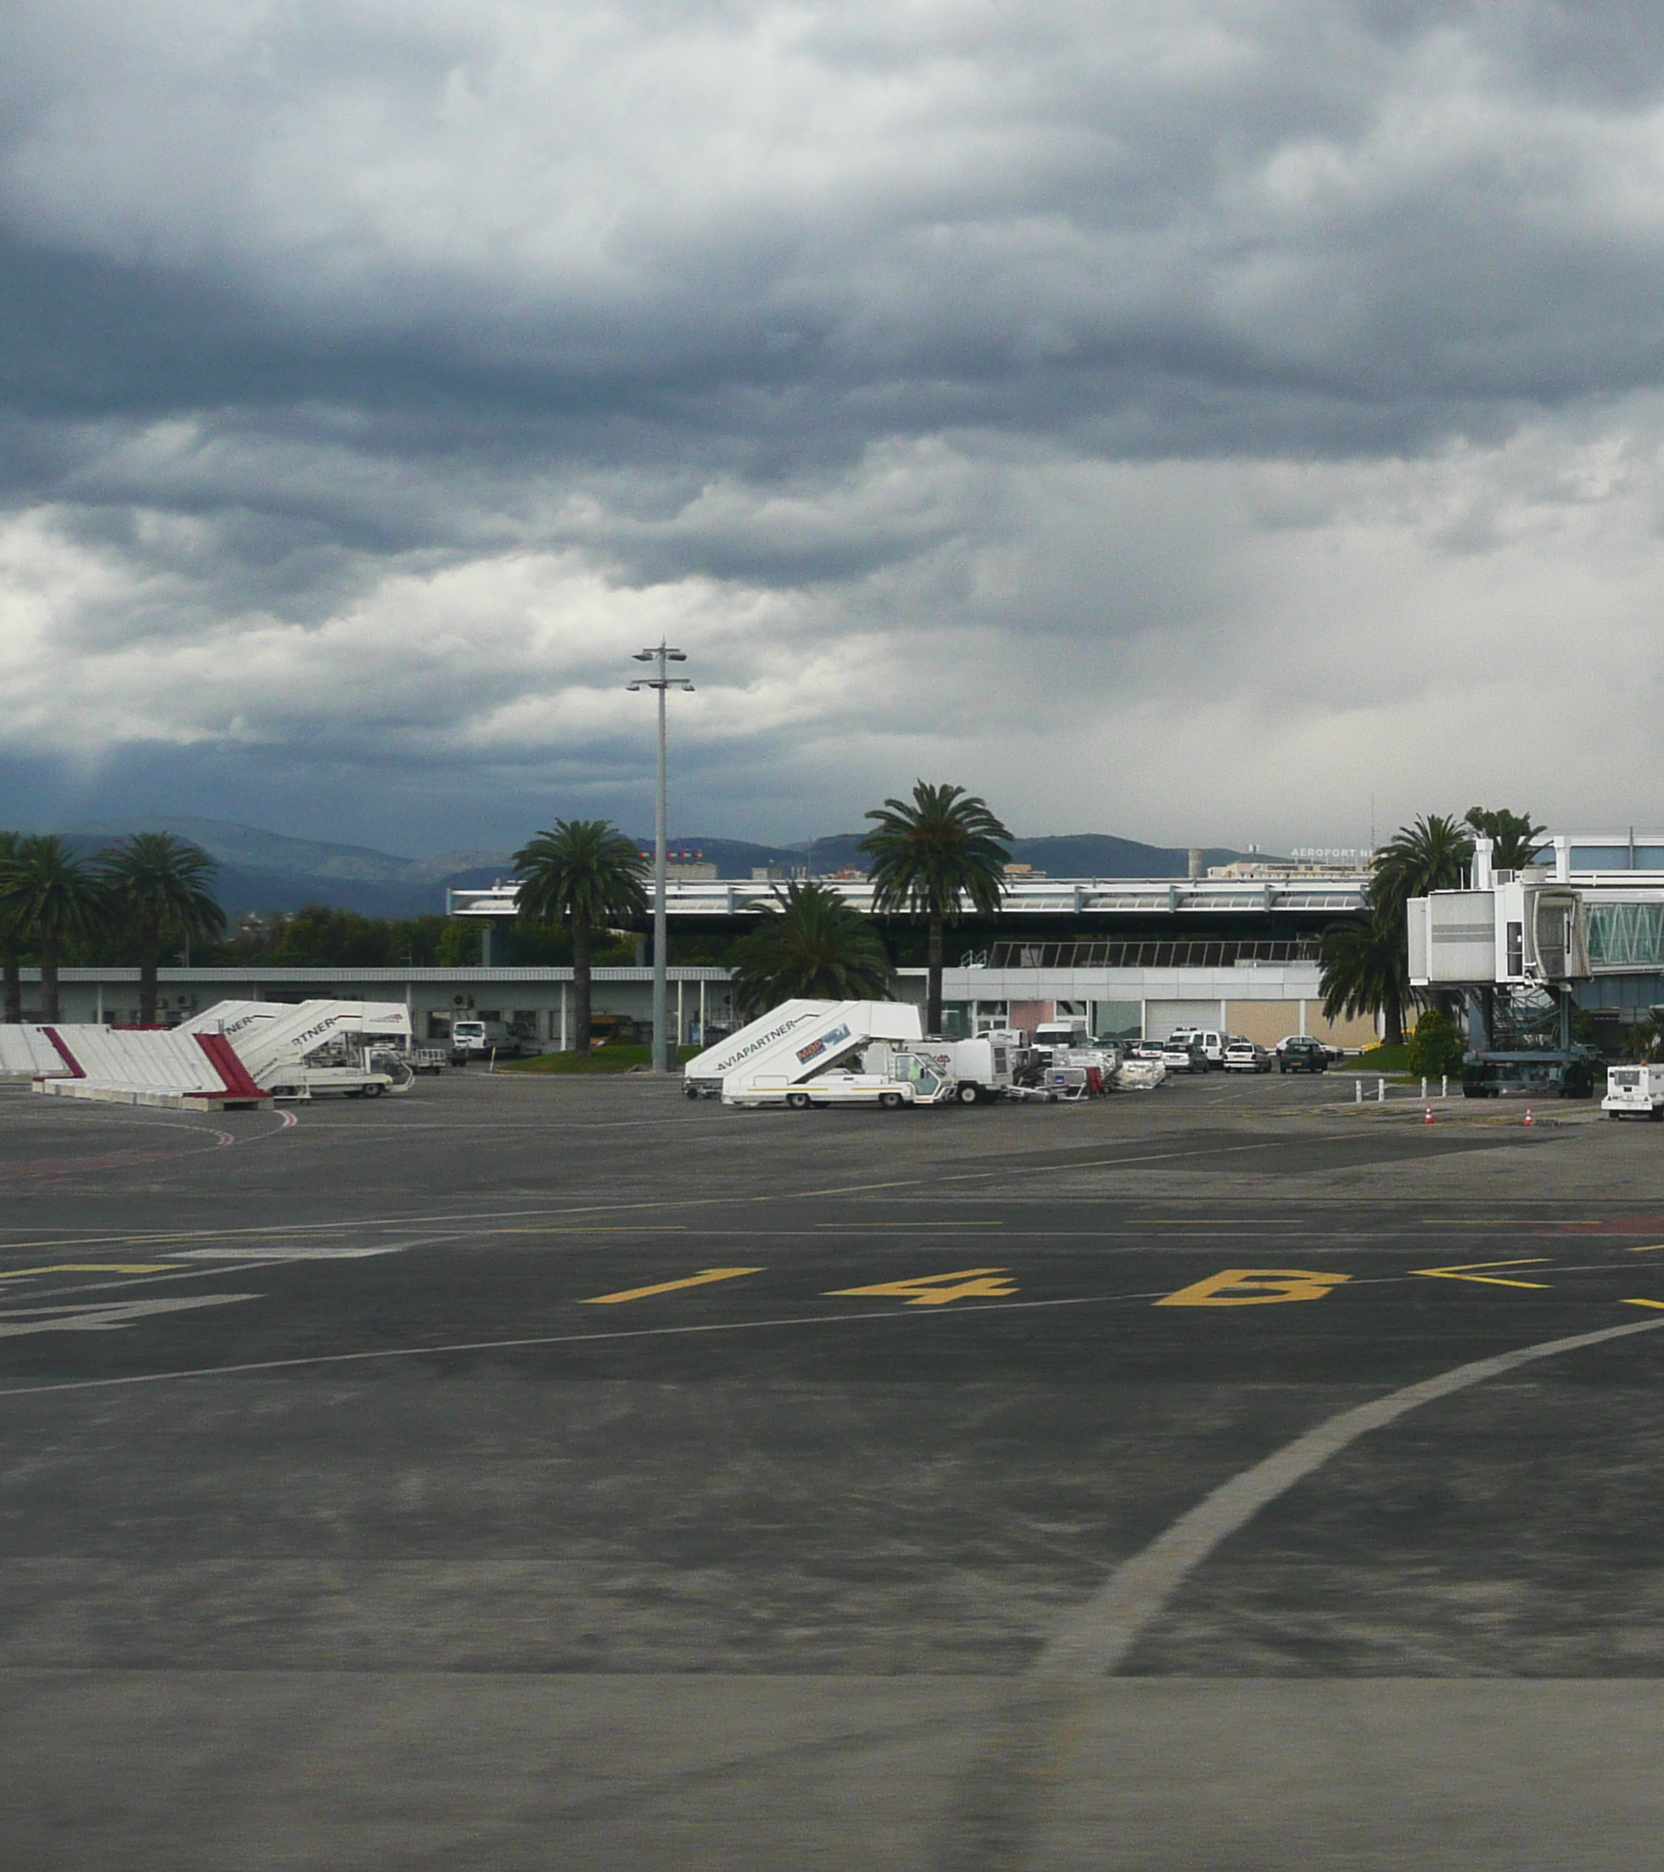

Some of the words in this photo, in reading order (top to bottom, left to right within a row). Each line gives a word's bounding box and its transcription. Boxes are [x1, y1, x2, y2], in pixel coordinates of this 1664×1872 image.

[1291, 848, 1356, 857] AEROPORT
[225, 1016, 253, 1036] NER
[715, 1020, 796, 1071] AVIAPARTNER
